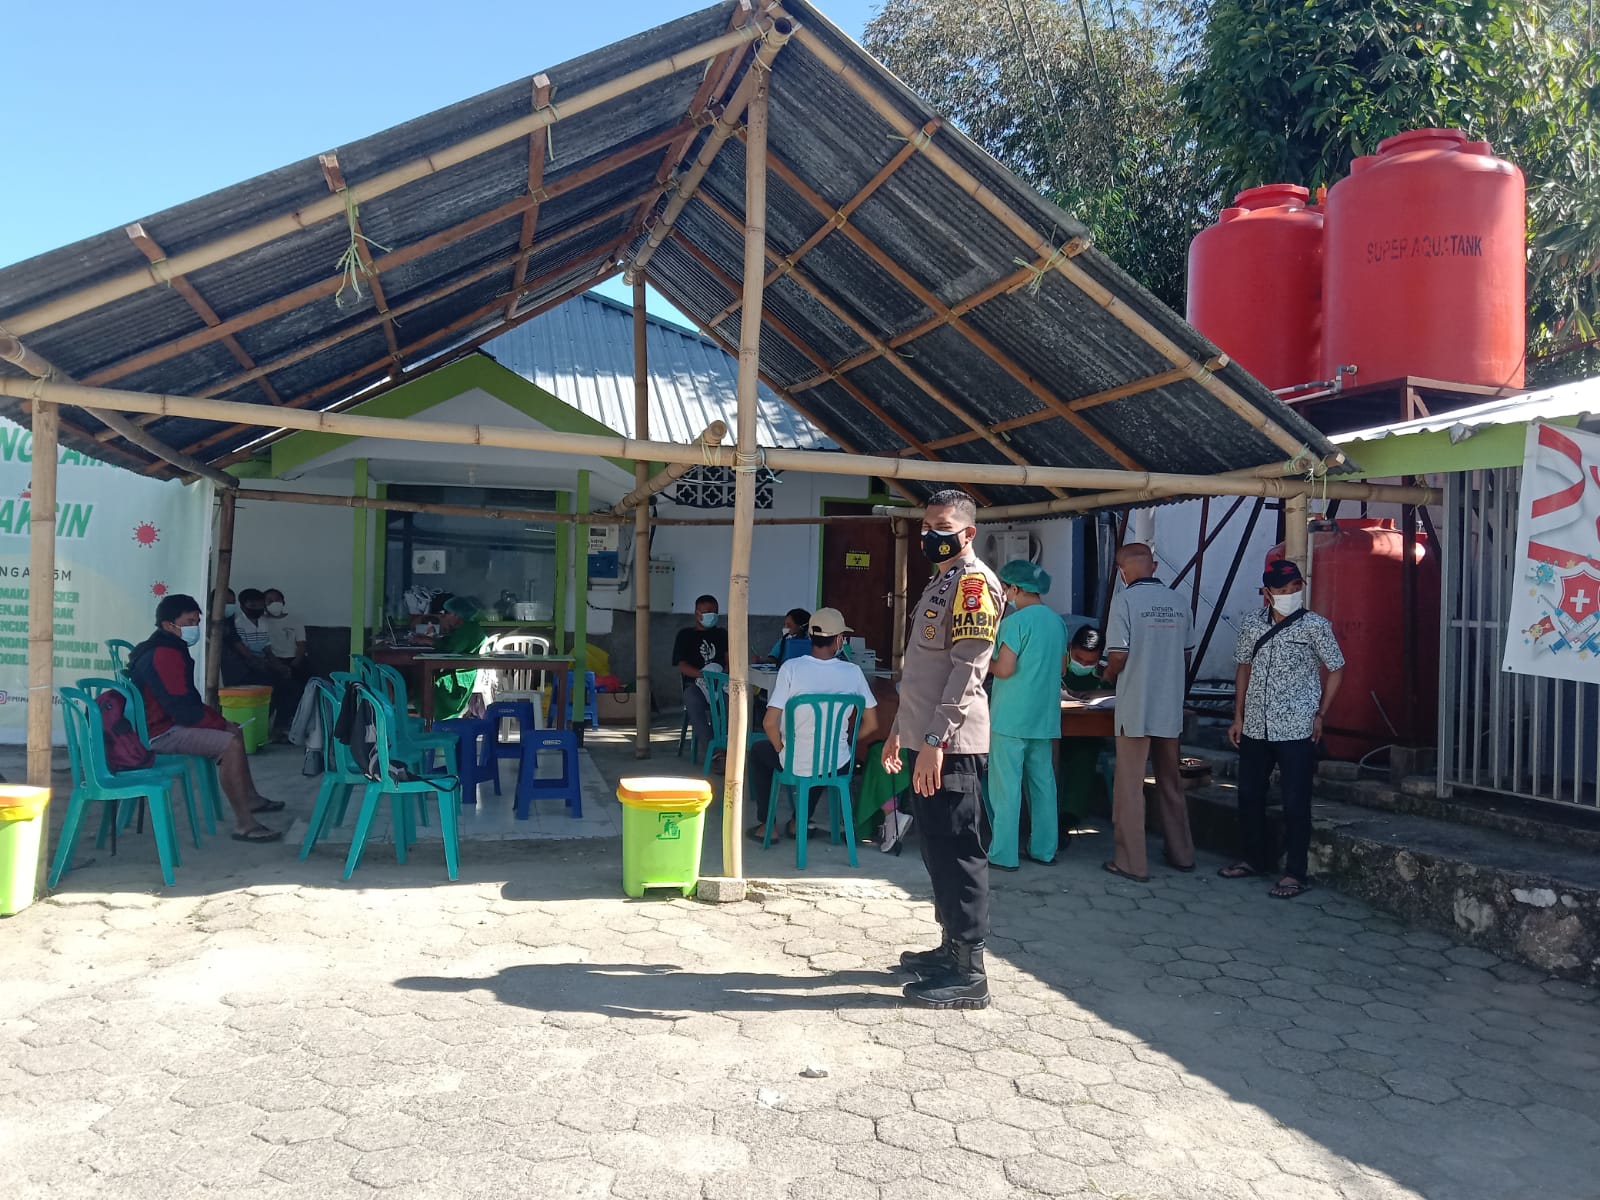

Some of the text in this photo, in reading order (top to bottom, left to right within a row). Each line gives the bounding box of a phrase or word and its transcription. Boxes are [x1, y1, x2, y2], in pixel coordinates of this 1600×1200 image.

[0, 499, 94, 538] AKIN
[929, 595, 947, 608] POLRI
[953, 612, 995, 627] HABI
